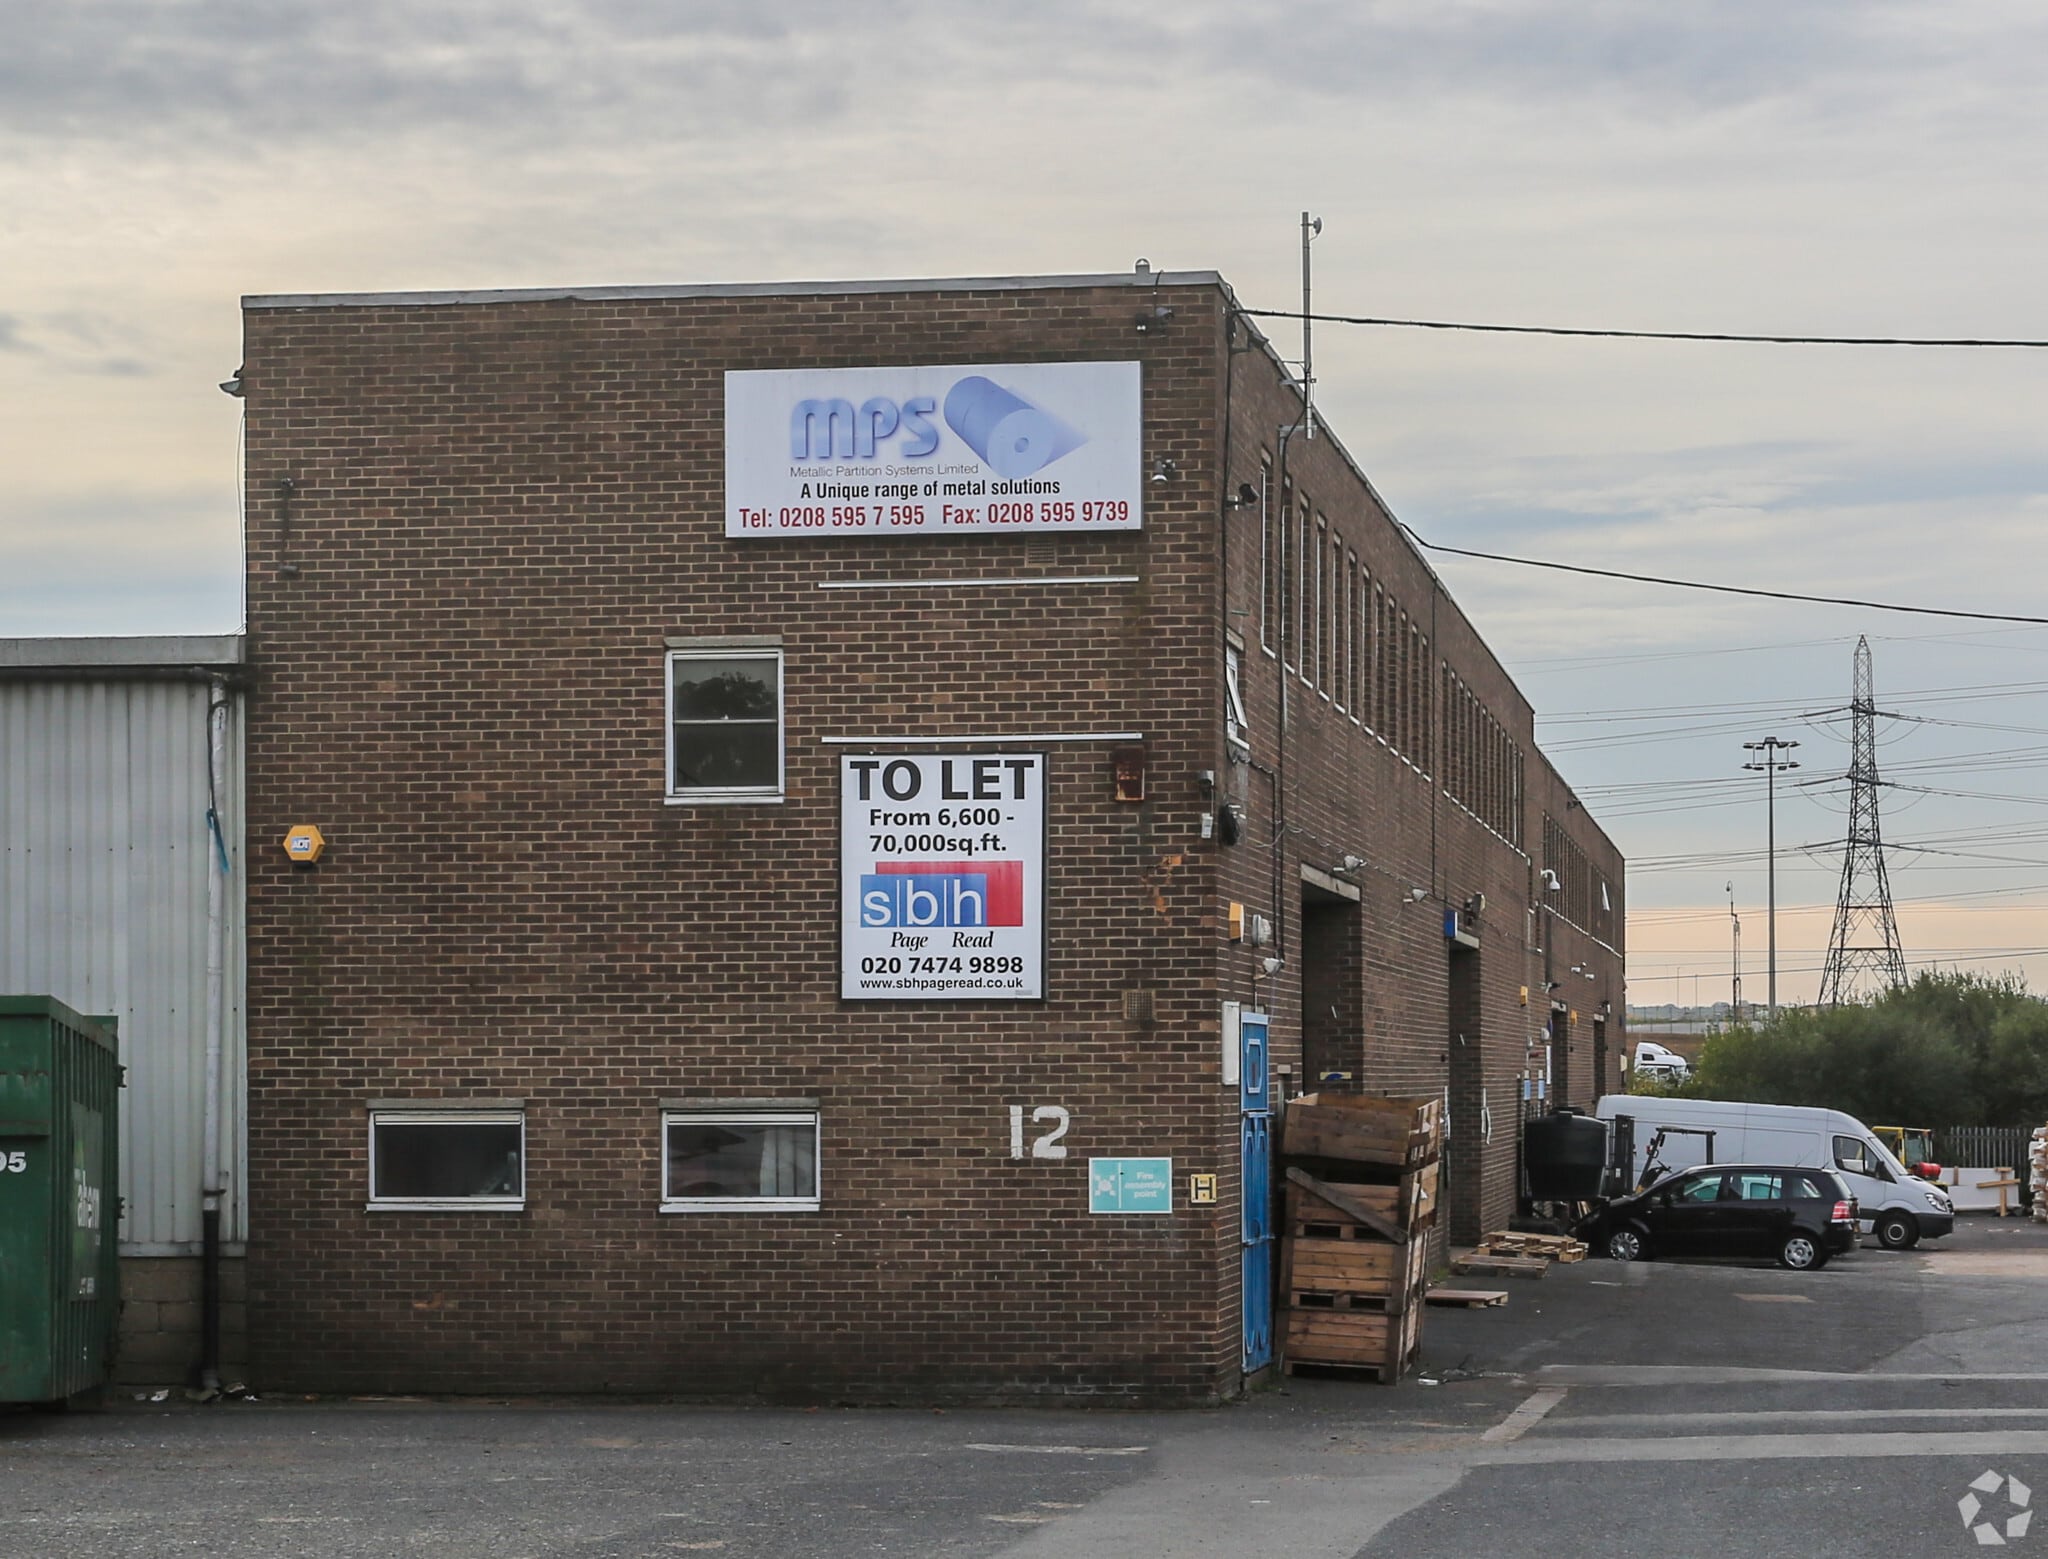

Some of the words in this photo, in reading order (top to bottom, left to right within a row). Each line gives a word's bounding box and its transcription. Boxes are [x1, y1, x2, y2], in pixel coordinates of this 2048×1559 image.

[790, 466, 832, 477] Metallic
[836, 465, 881, 477] Partition
[885, 465, 933, 478] Systems
[938, 464, 978, 475] Limited
[801, 483, 811, 498] A
[817, 482, 868, 500] Unique
[875, 484, 918, 500] range
[924, 481, 938, 496] of
[944, 480, 985, 496] metal
[991, 479, 1060, 494] solutions
[739, 508, 772, 528] Tel:
[780, 507, 825, 528] 0208
[832, 506, 866, 526] 595
[873, 506, 883, 526] 7
[890, 505, 925, 526] 595
[943, 504, 980, 524] Fax:
[988, 503, 1033, 523] 0208
[1041, 502, 1075, 522] 595
[1082, 501, 1128, 521] 9739
[850, 759, 921, 801] TO
[941, 759, 1034, 800] LET
[870, 808, 930, 826] From
[938, 808, 1000, 828] 6,600
[870, 833, 1007, 856] 70,000sq.ft.
[890, 931, 928, 951] Page
[952, 931, 994, 948] Read
[861, 957, 901, 974] 020
[908, 957, 962, 974] 7474
[969, 956, 1023, 974] 9898
[860, 977, 1023, 991] www.sbhpageread.co.uk
[1009, 1104, 1070, 1160] 12
